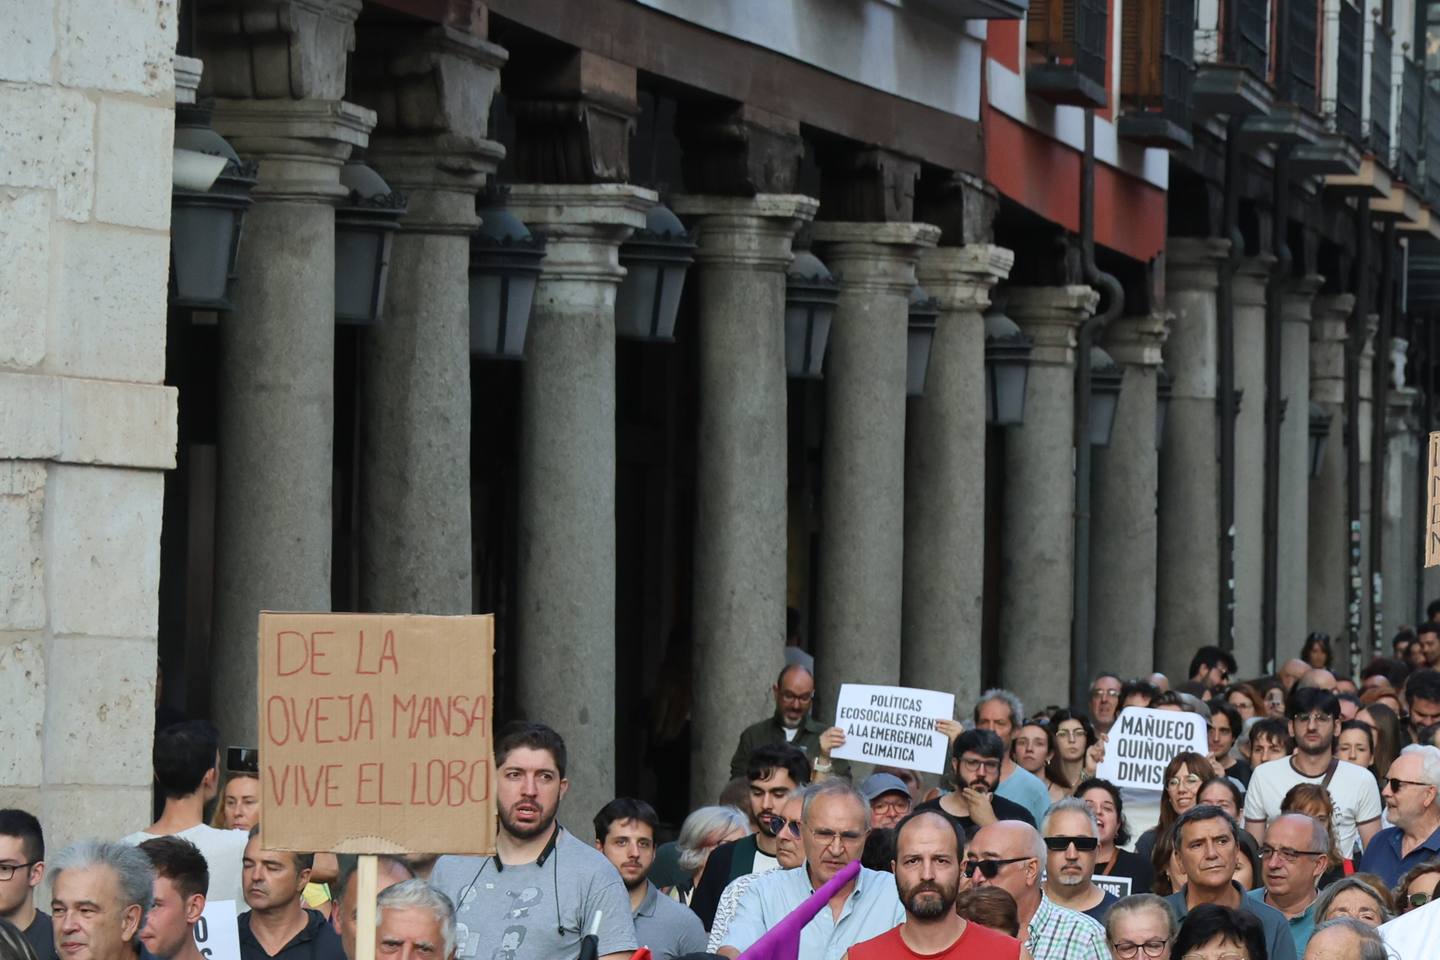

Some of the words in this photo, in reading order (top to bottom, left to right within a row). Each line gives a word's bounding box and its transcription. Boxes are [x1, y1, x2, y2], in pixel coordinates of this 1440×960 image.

[277, 630, 335, 677] DE
[355, 630, 399, 675] LA
[870, 694, 923, 713] POLÍTICAS
[267, 692, 374, 746] OVEJA
[391, 693, 488, 739] MANSA
[840, 707, 909, 727] ECOSOCIALES
[909, 715, 936, 731] FREN
[1120, 714, 1195, 741] MAÑUECO
[848, 724, 855, 736] A
[856, 725, 868, 738] LA
[870, 726, 933, 748] EMERGENCIA
[862, 742, 915, 762] CLIMÁTICA
[268, 764, 343, 807] VIVE
[356, 762, 404, 806] EL
[410, 758, 490, 807] LOBO
